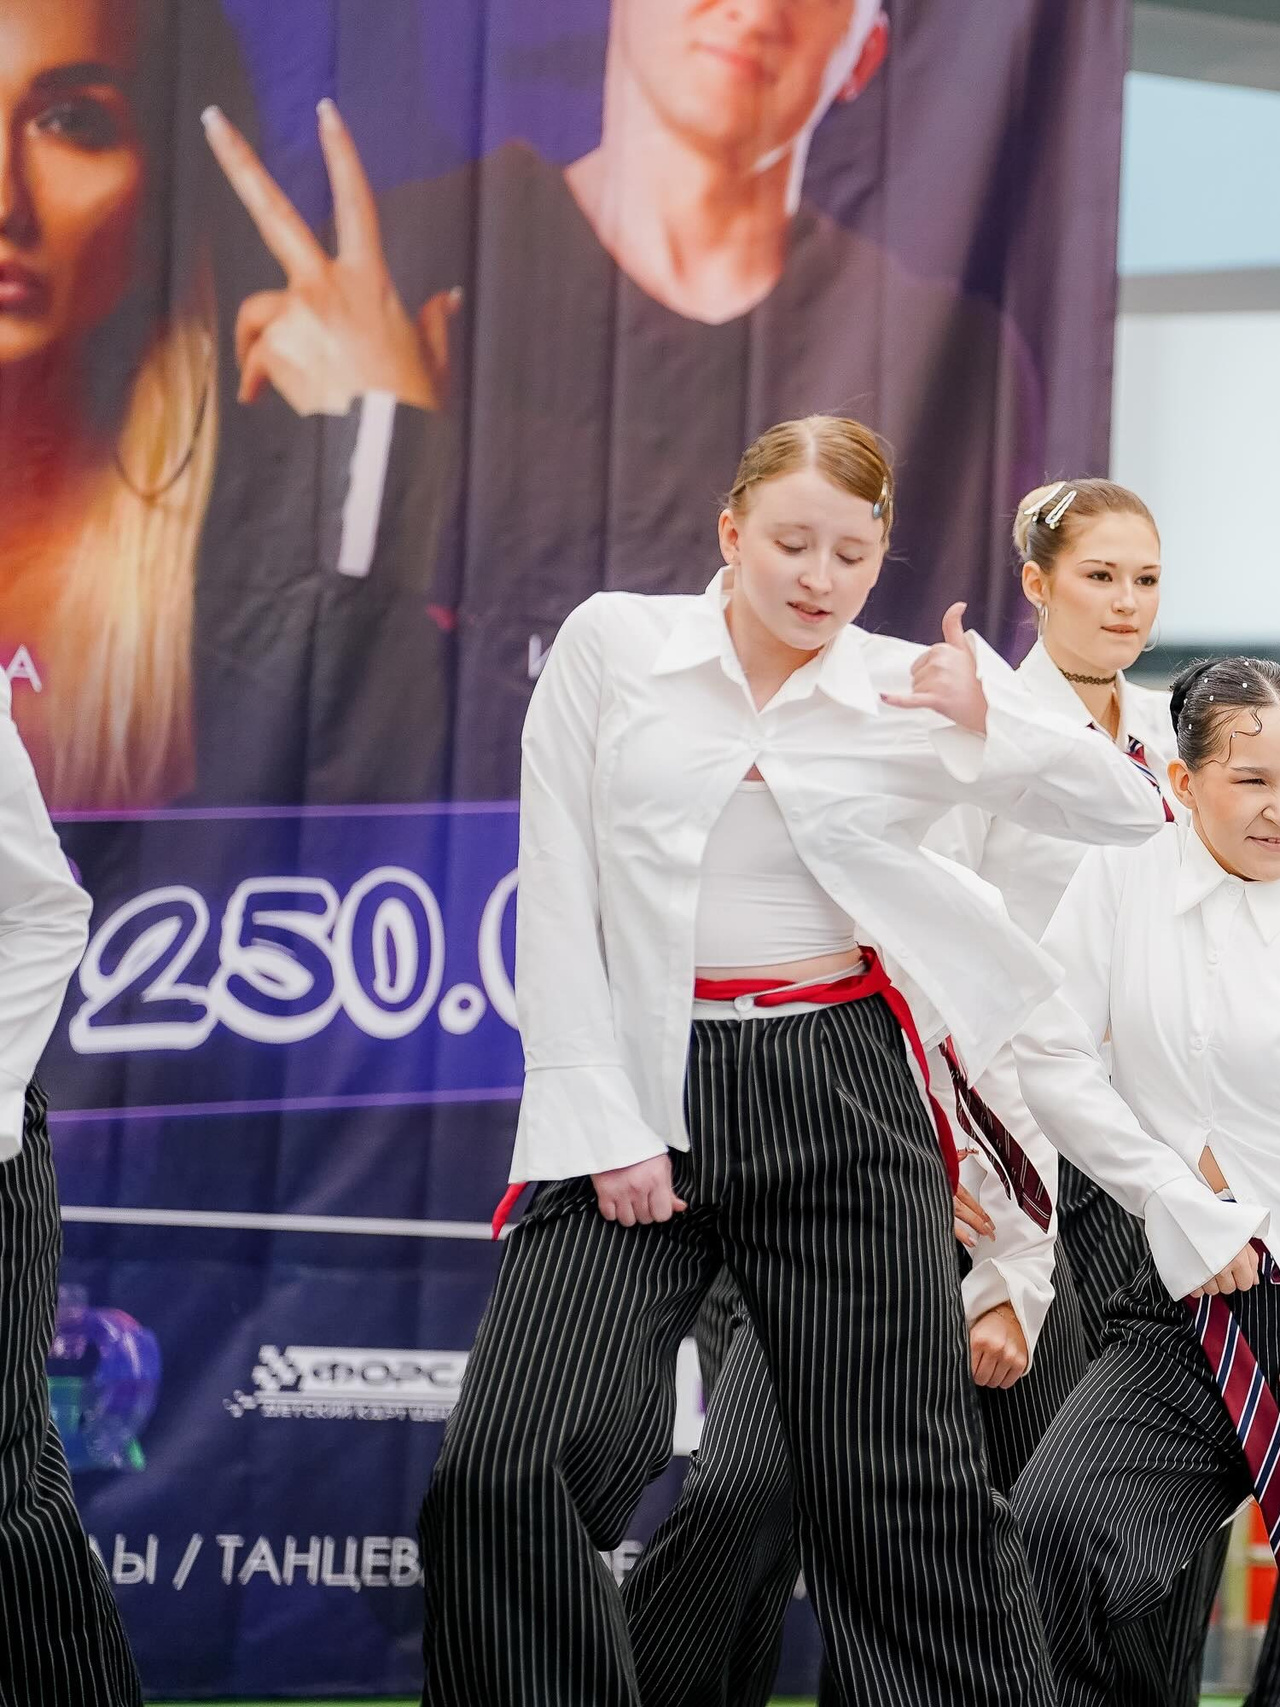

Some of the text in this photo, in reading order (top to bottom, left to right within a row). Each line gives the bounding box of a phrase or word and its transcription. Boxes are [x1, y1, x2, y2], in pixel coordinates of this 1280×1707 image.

[313, 1360, 467, 1390] ФОРС
[88, 1532, 159, 1586] Ы
[216, 1533, 425, 1593] ТАНЦЕВ
